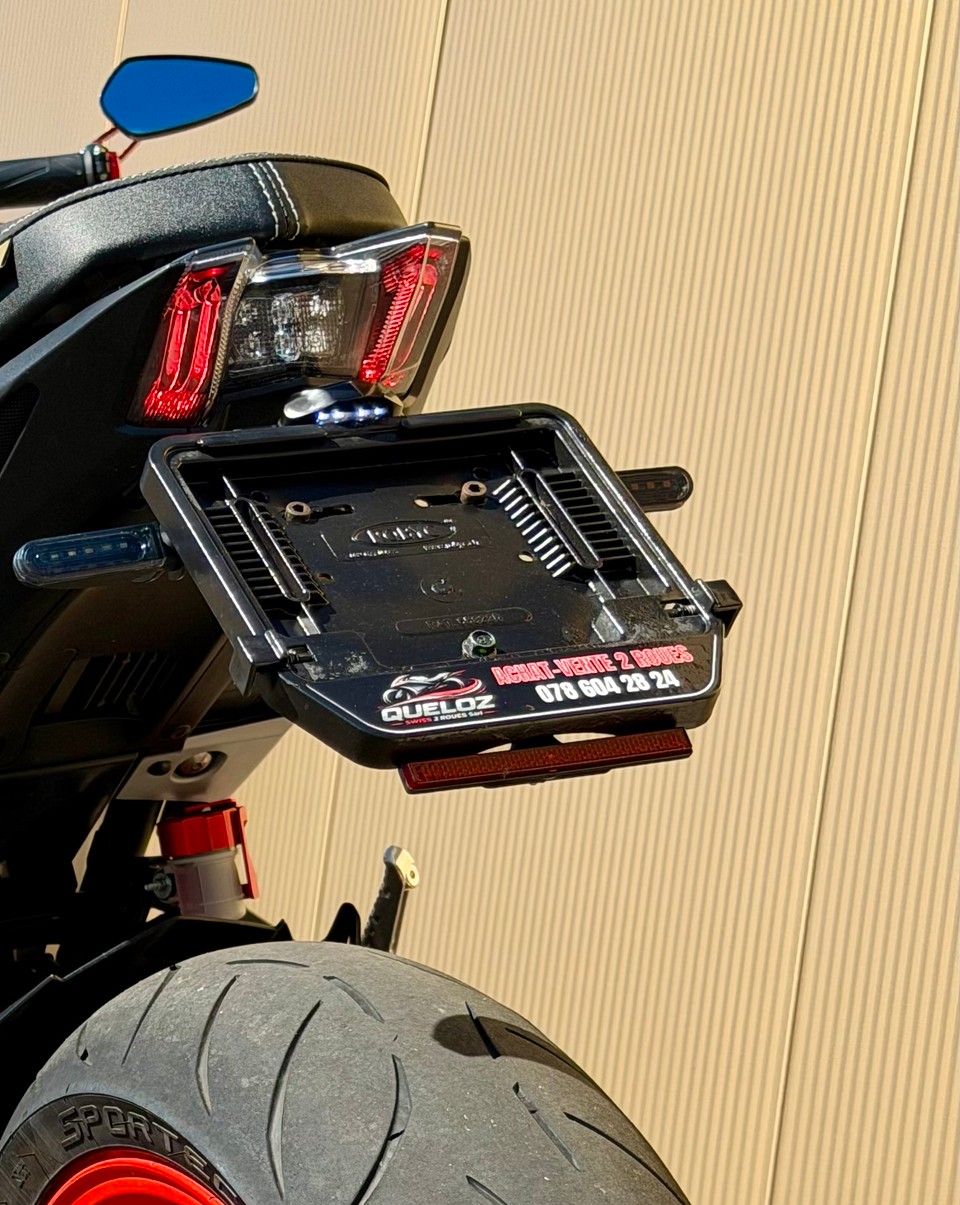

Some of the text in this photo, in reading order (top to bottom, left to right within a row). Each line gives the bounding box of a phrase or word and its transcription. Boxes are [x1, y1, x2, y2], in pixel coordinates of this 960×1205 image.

[491, 644, 694, 686] ACHAT-VENTE 2 ROUES
[535, 669, 680, 703] 078 604 28 24
[381, 695, 495, 722] QUELOZ
[405, 717, 433, 725] SWISS
[439, 713, 468, 721] ROUES
